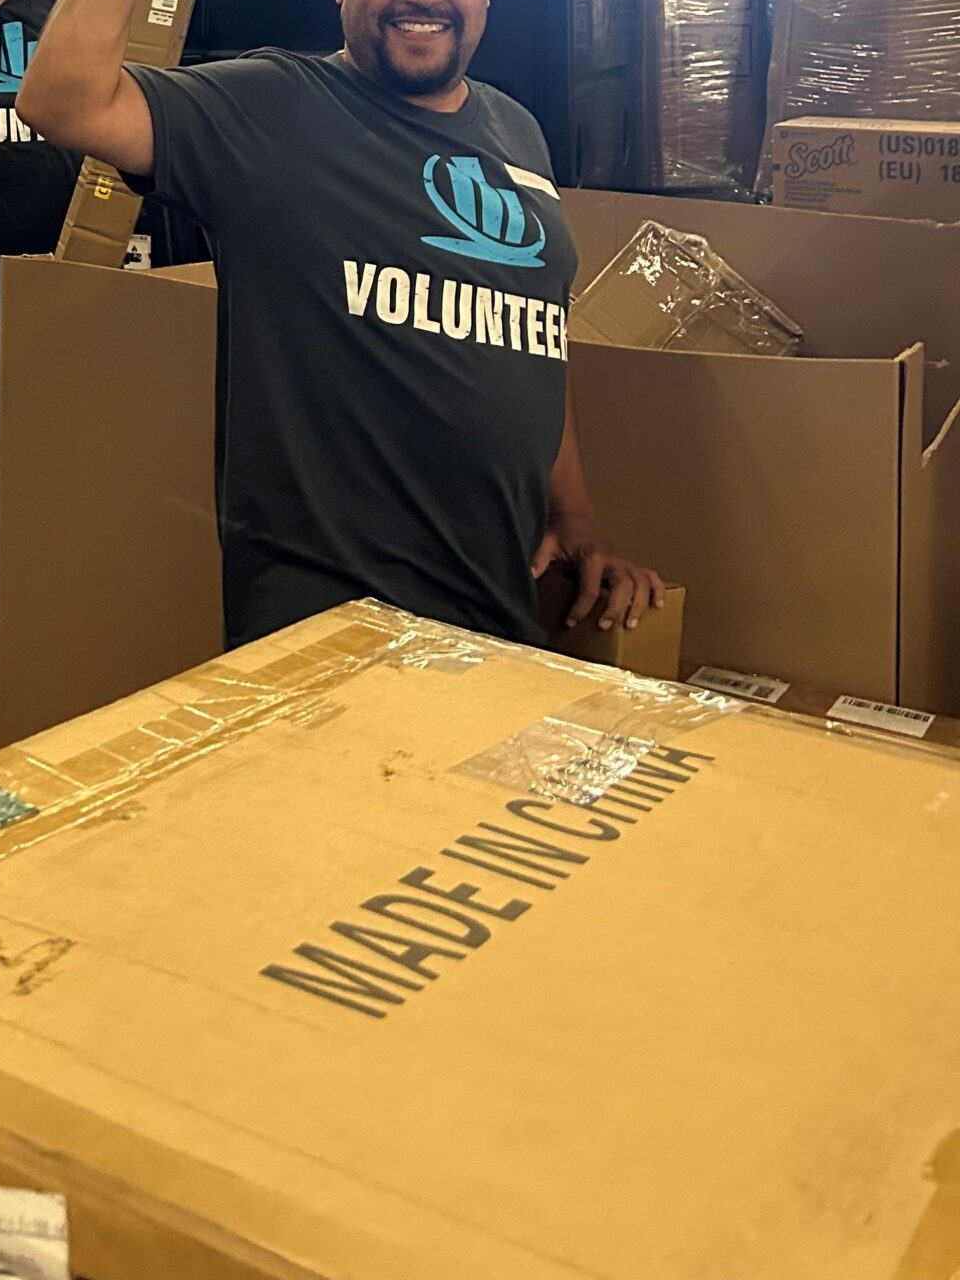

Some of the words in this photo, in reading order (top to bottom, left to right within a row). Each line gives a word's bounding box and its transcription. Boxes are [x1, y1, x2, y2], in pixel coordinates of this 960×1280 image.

[784, 133, 855, 179] Scott
[879, 161, 921, 183] (EU)
[505, 743, 716, 842] CHINA
[440, 821, 591, 890] IN
[259, 866, 533, 1019] MADE
